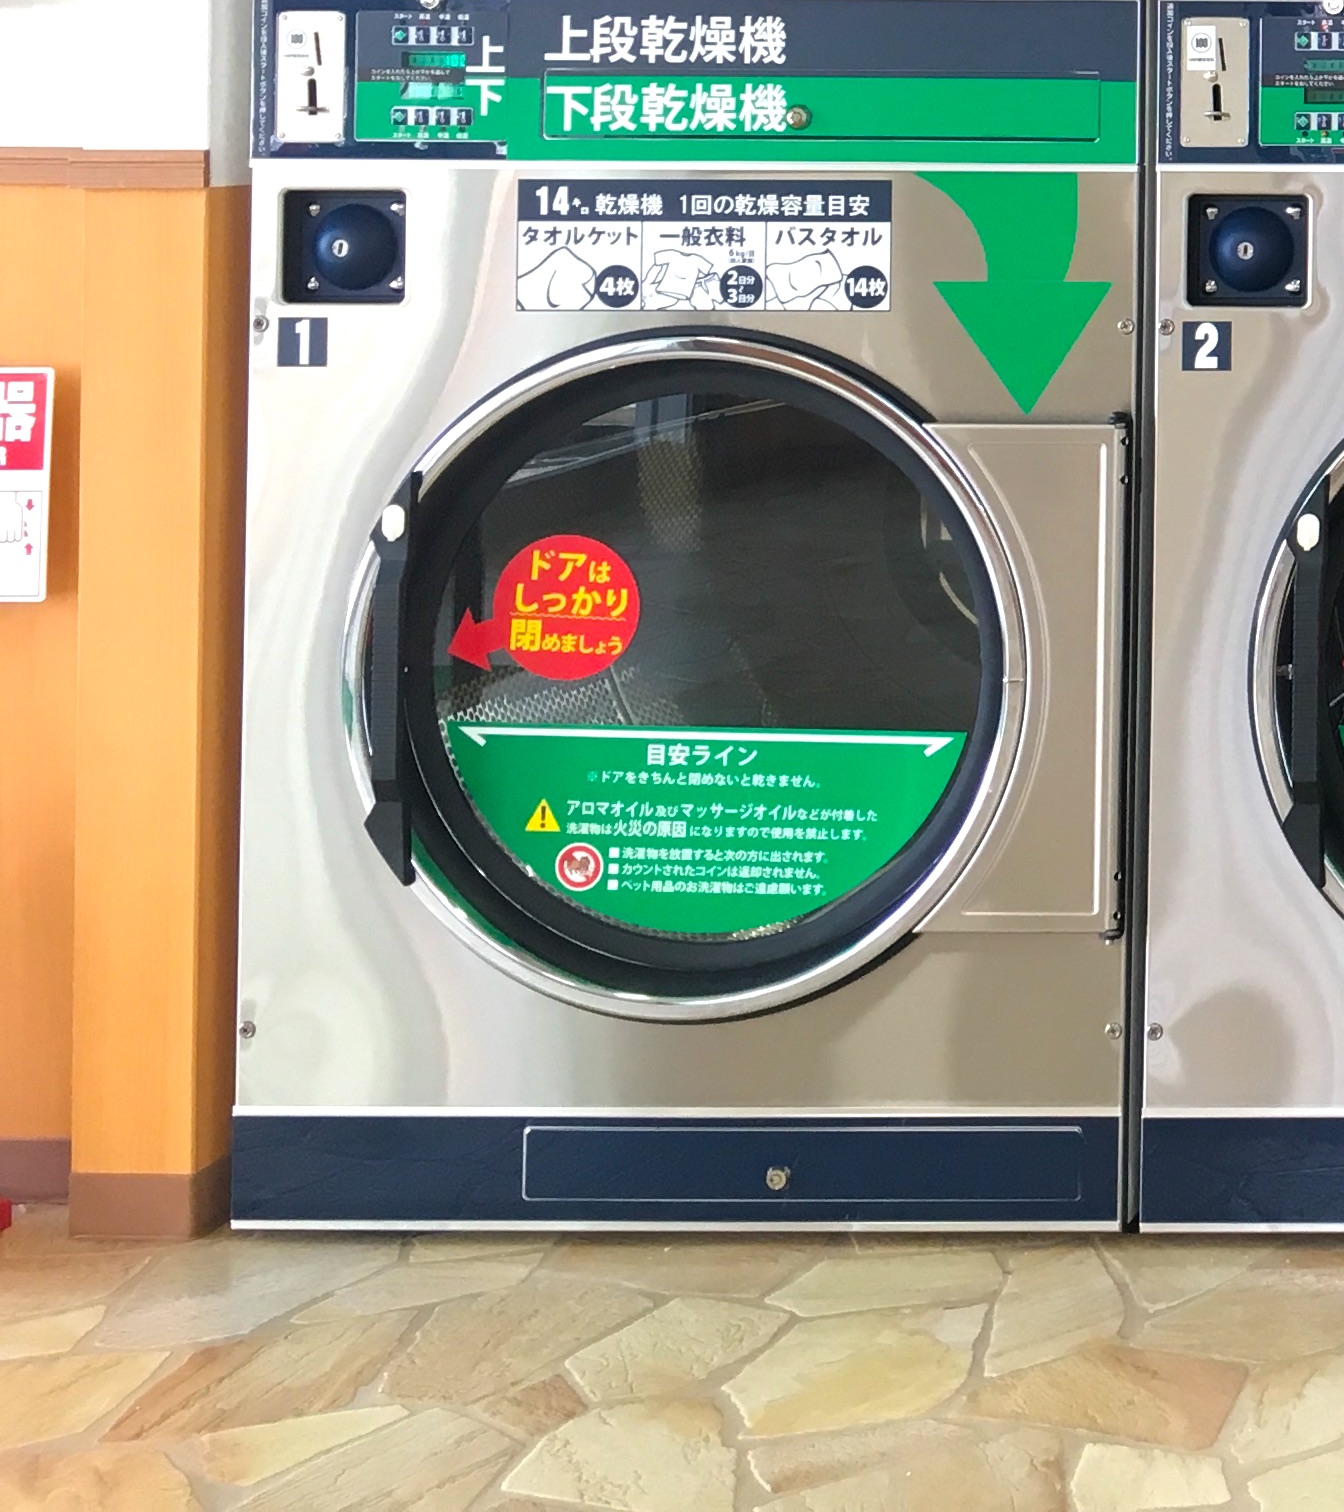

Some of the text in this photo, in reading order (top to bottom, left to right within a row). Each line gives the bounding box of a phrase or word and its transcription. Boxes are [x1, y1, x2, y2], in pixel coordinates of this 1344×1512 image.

[468, 35, 506, 73] 上
[544, 16, 786, 64] 上段乾燥機
[465, 79, 506, 116] 下
[547, 84, 787, 133] 下段乾燥機
[679, 193, 870, 216] 1回の乾燥容量目安
[522, 226, 639, 246] タオルケット
[660, 227, 746, 246] 一般衣料
[776, 227, 882, 246] バスタオル
[600, 275, 633, 298] 4枚
[727, 271, 756, 286] 2日分
[847, 275, 885, 297] 14枚
[727, 289, 756, 305] 3日分
[294, 320, 310, 364] 1
[1194, 323, 1218, 369] 2
[530, 549, 610, 583] ドアは
[516, 584, 627, 617] しっかり
[509, 619, 622, 655] 閉めましょう
[646, 743, 758, 767] 目安ライン
